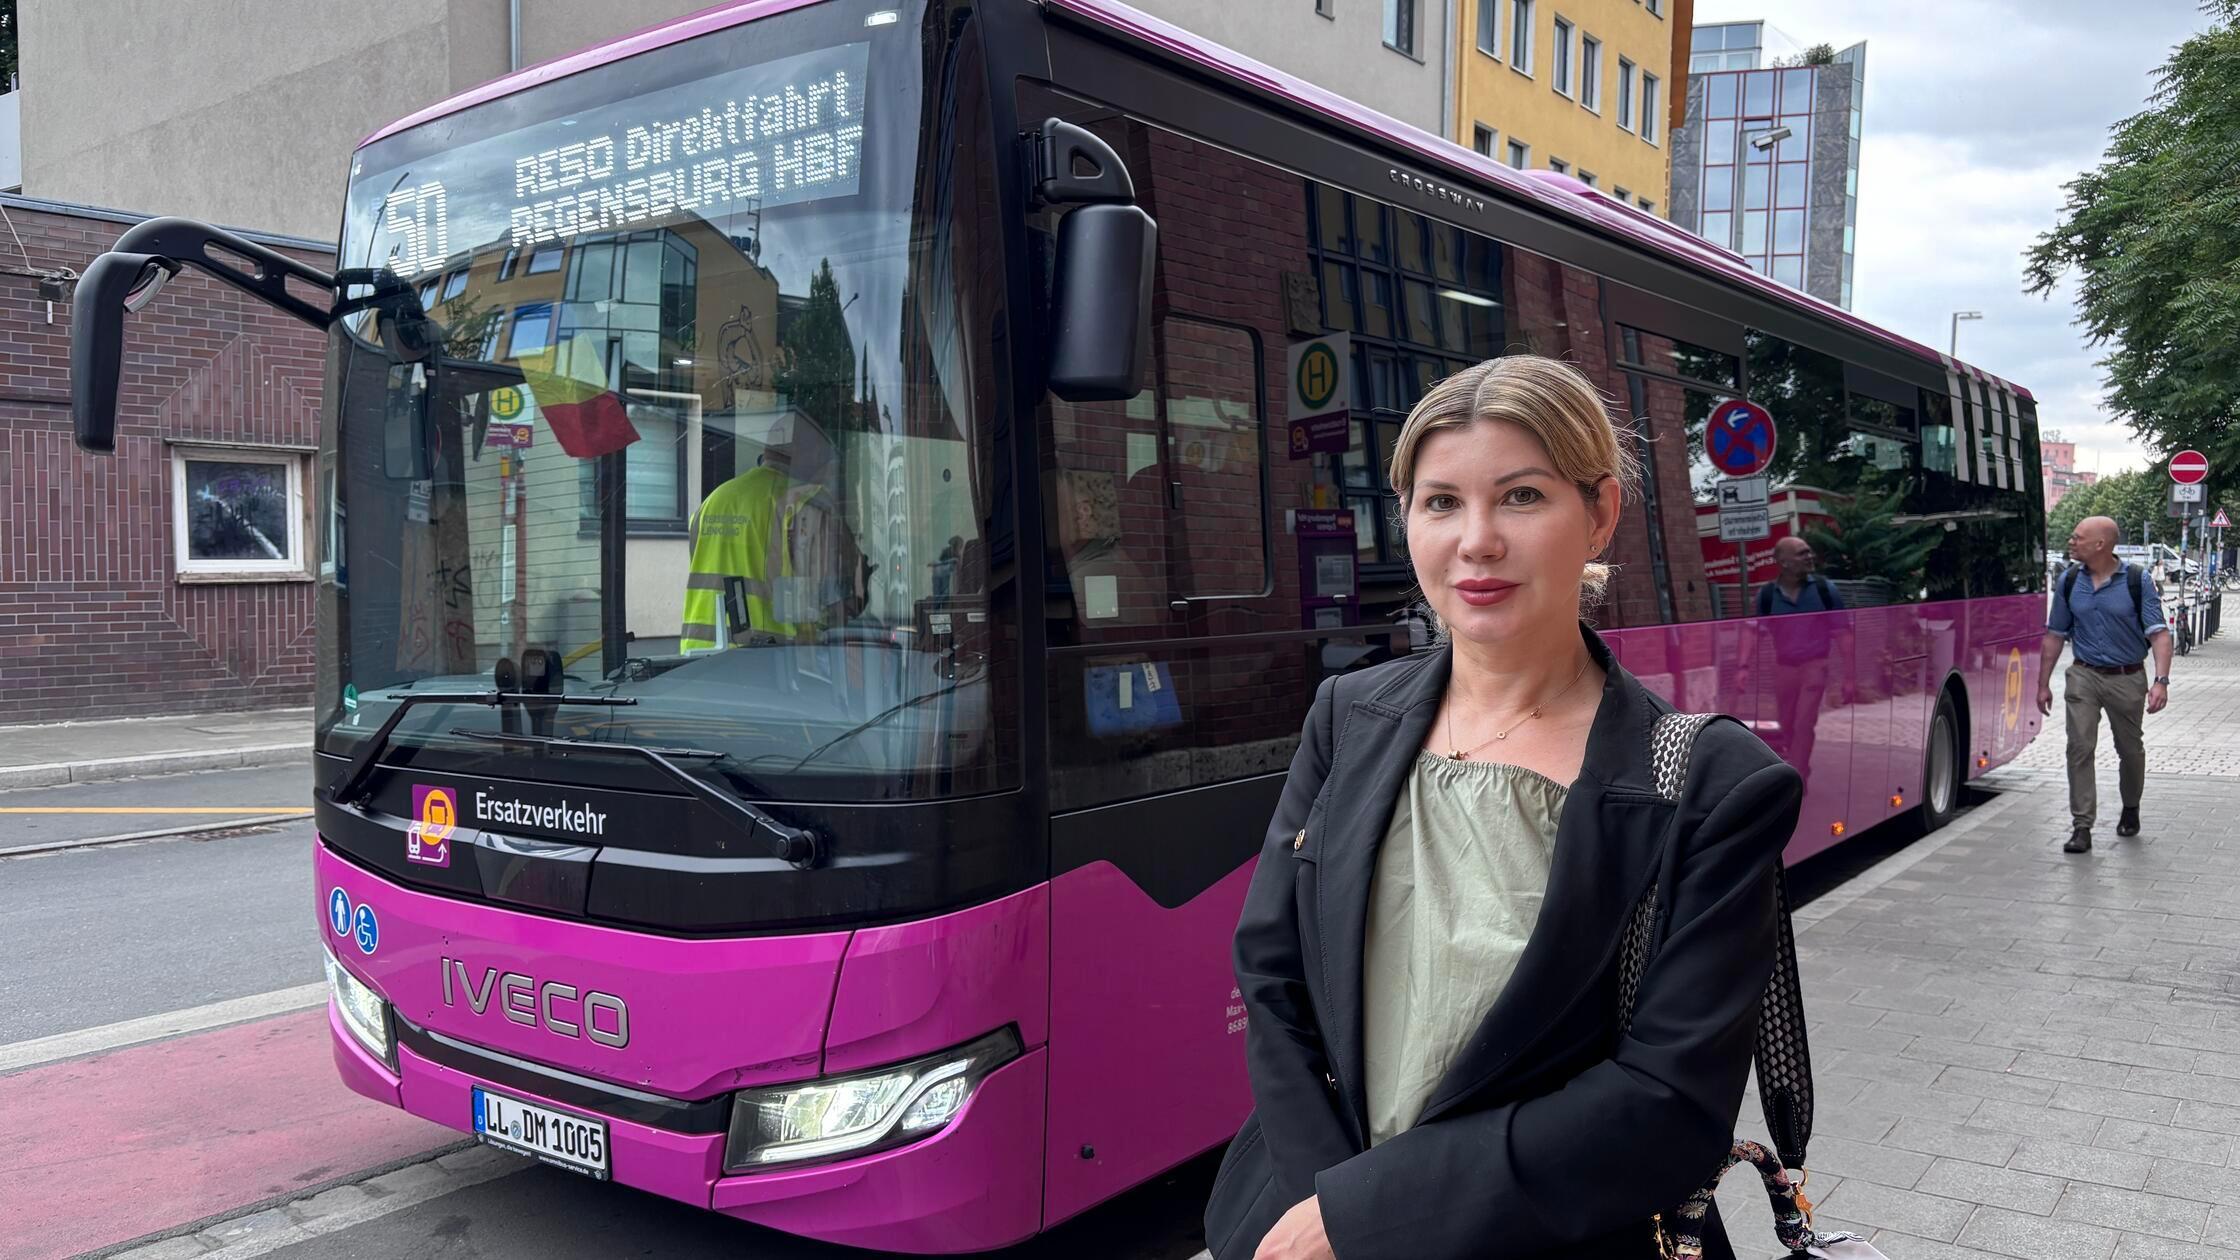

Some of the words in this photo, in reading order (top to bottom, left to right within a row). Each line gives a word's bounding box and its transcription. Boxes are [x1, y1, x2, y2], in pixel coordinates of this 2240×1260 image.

[626, 71, 850, 170] Direktfahrt
[386, 180, 448, 278] 50
[510, 151, 759, 247] REGENSBURG
[774, 125, 863, 190] HBF
[1388, 168, 1485, 213] CROSSWAY
[476, 791, 607, 835] Ersatzverkehr
[441, 957, 629, 1050] IVECO
[486, 1098, 509, 1136] LL
[522, 1109, 547, 1148] DM
[551, 1118, 601, 1162] 1005
